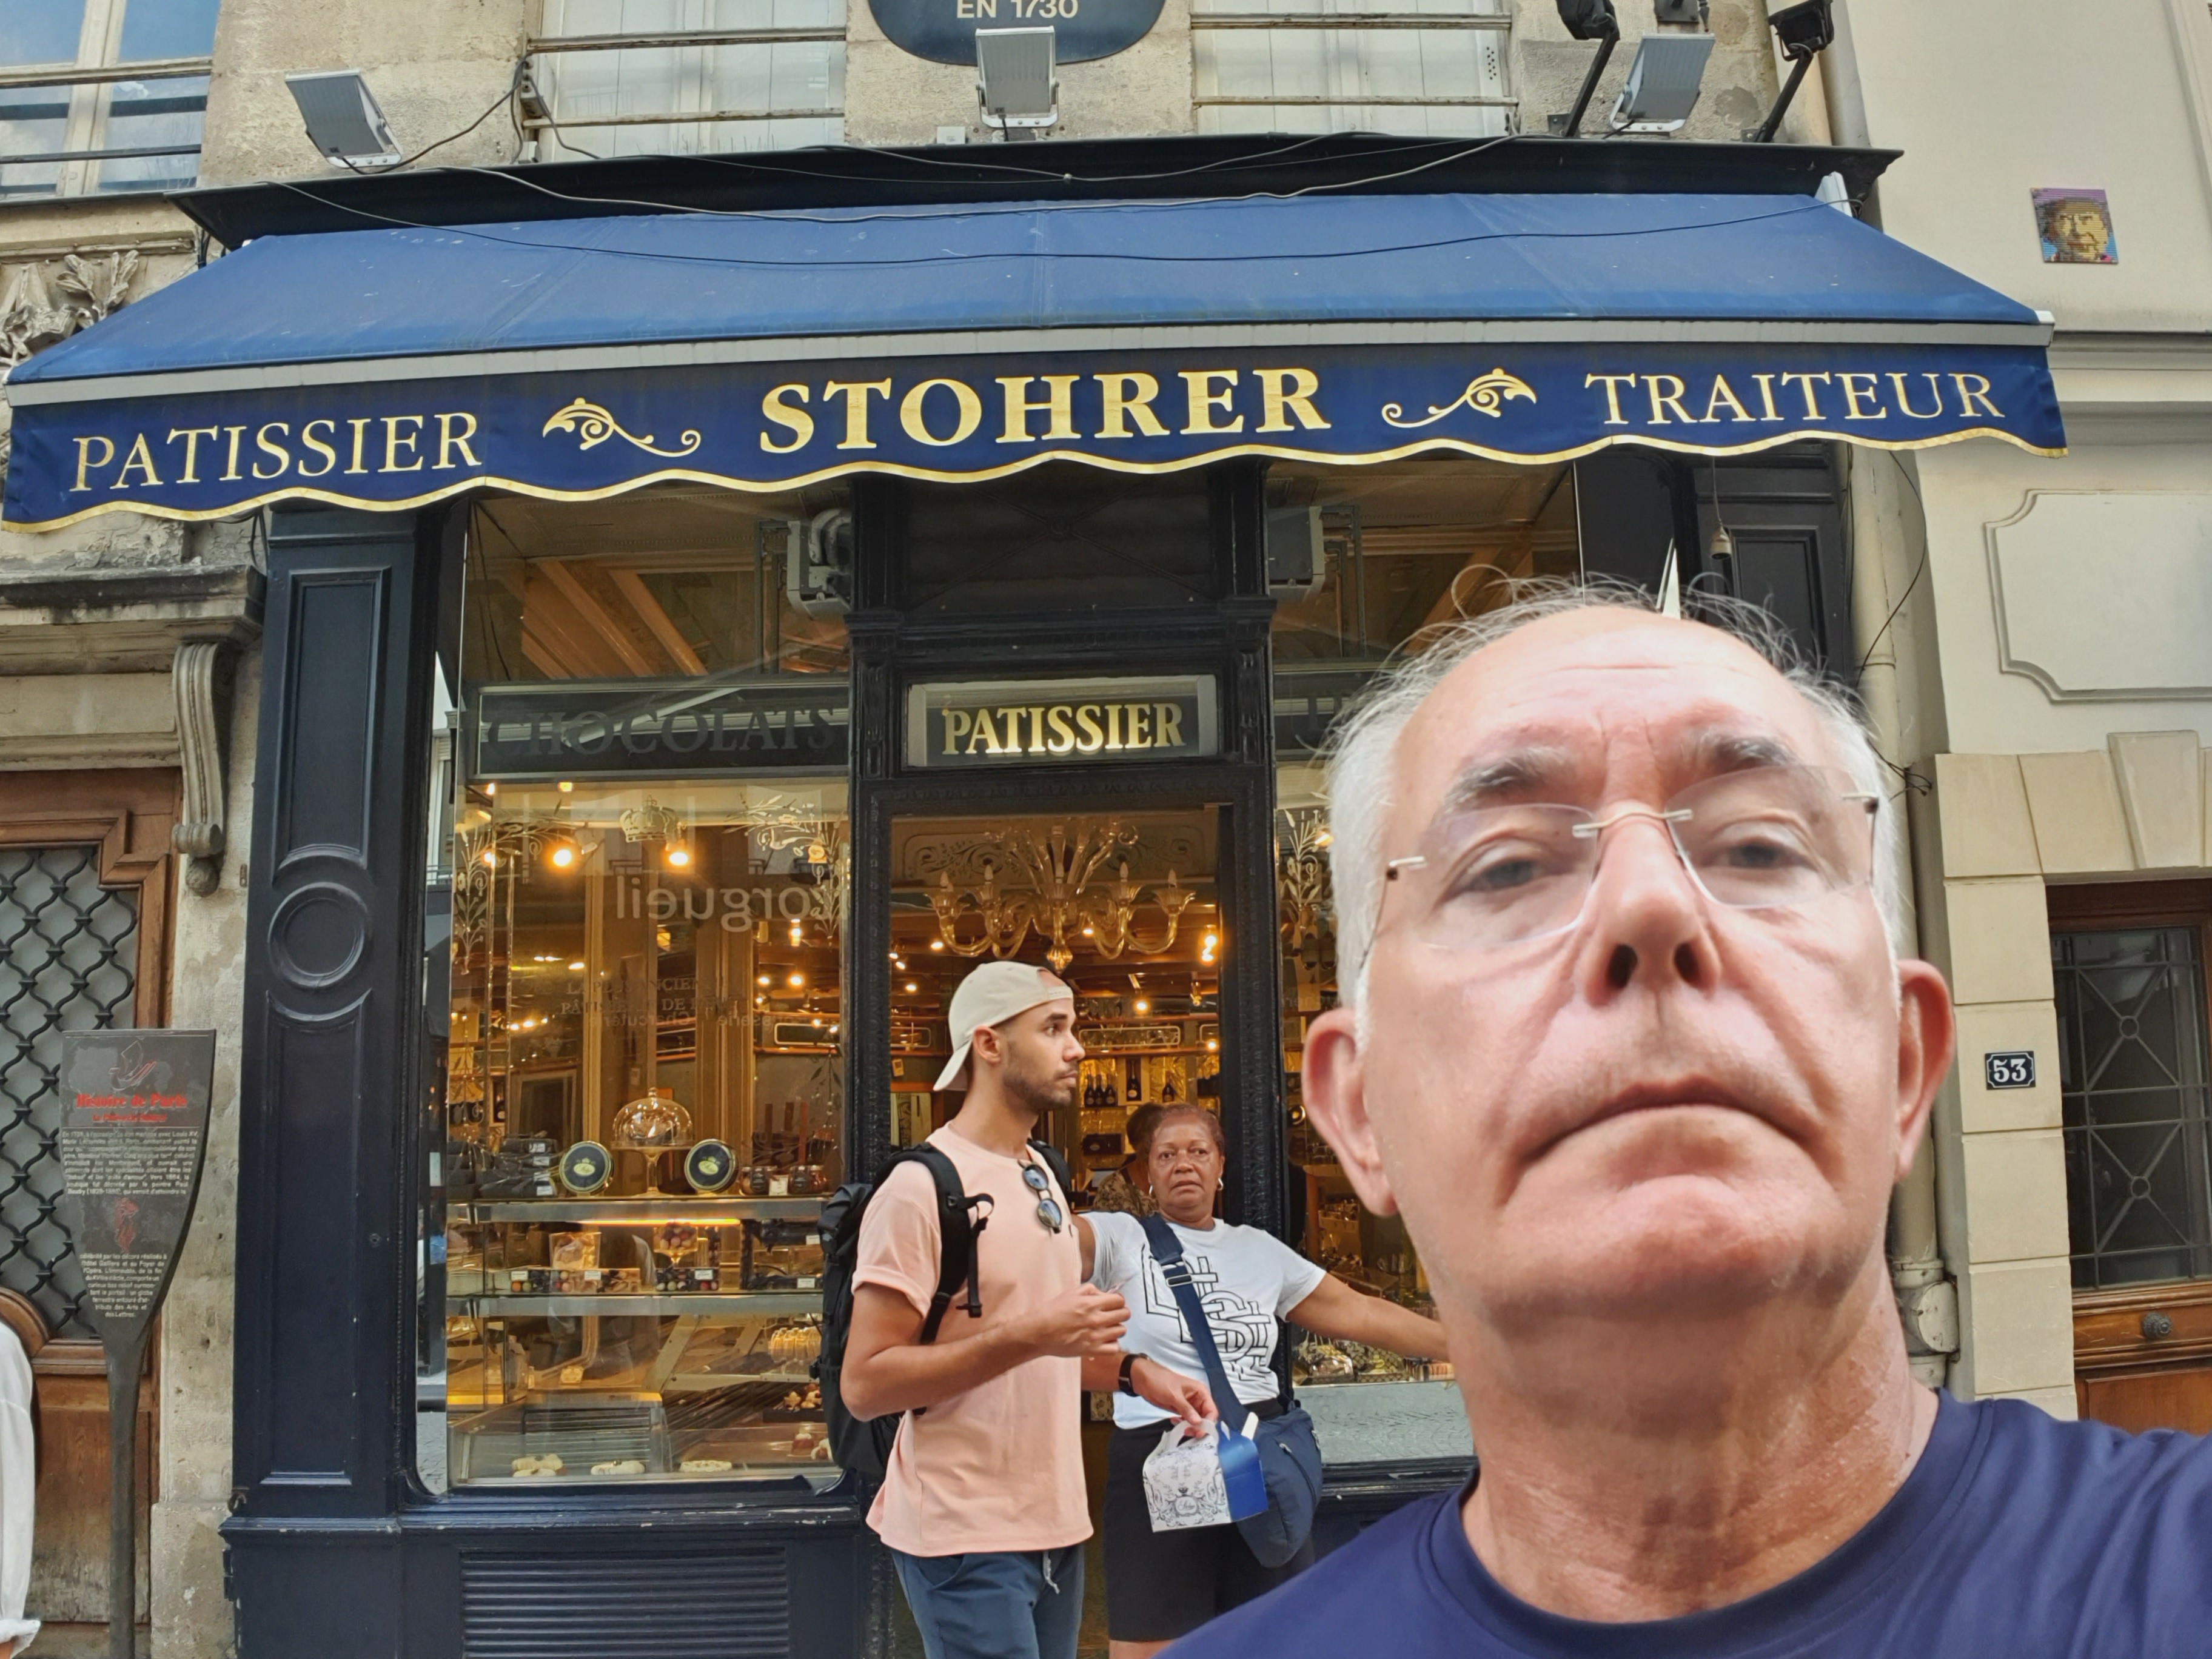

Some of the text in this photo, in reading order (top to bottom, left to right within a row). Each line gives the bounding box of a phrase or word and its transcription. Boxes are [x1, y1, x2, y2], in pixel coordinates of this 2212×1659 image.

[957, 0, 1078, 18] EN 1730
[69, 367, 2006, 492] PATISSIER STOHRER TRAITEUR
[486, 707, 837, 756] CHOCOLATS
[942, 702, 1187, 755] PATISSIER
[662, 998, 686, 1011] DE
[1993, 1058, 2026, 1082] 53
[131, 1093, 147, 1108] de
[150, 1093, 187, 1108] Paris
